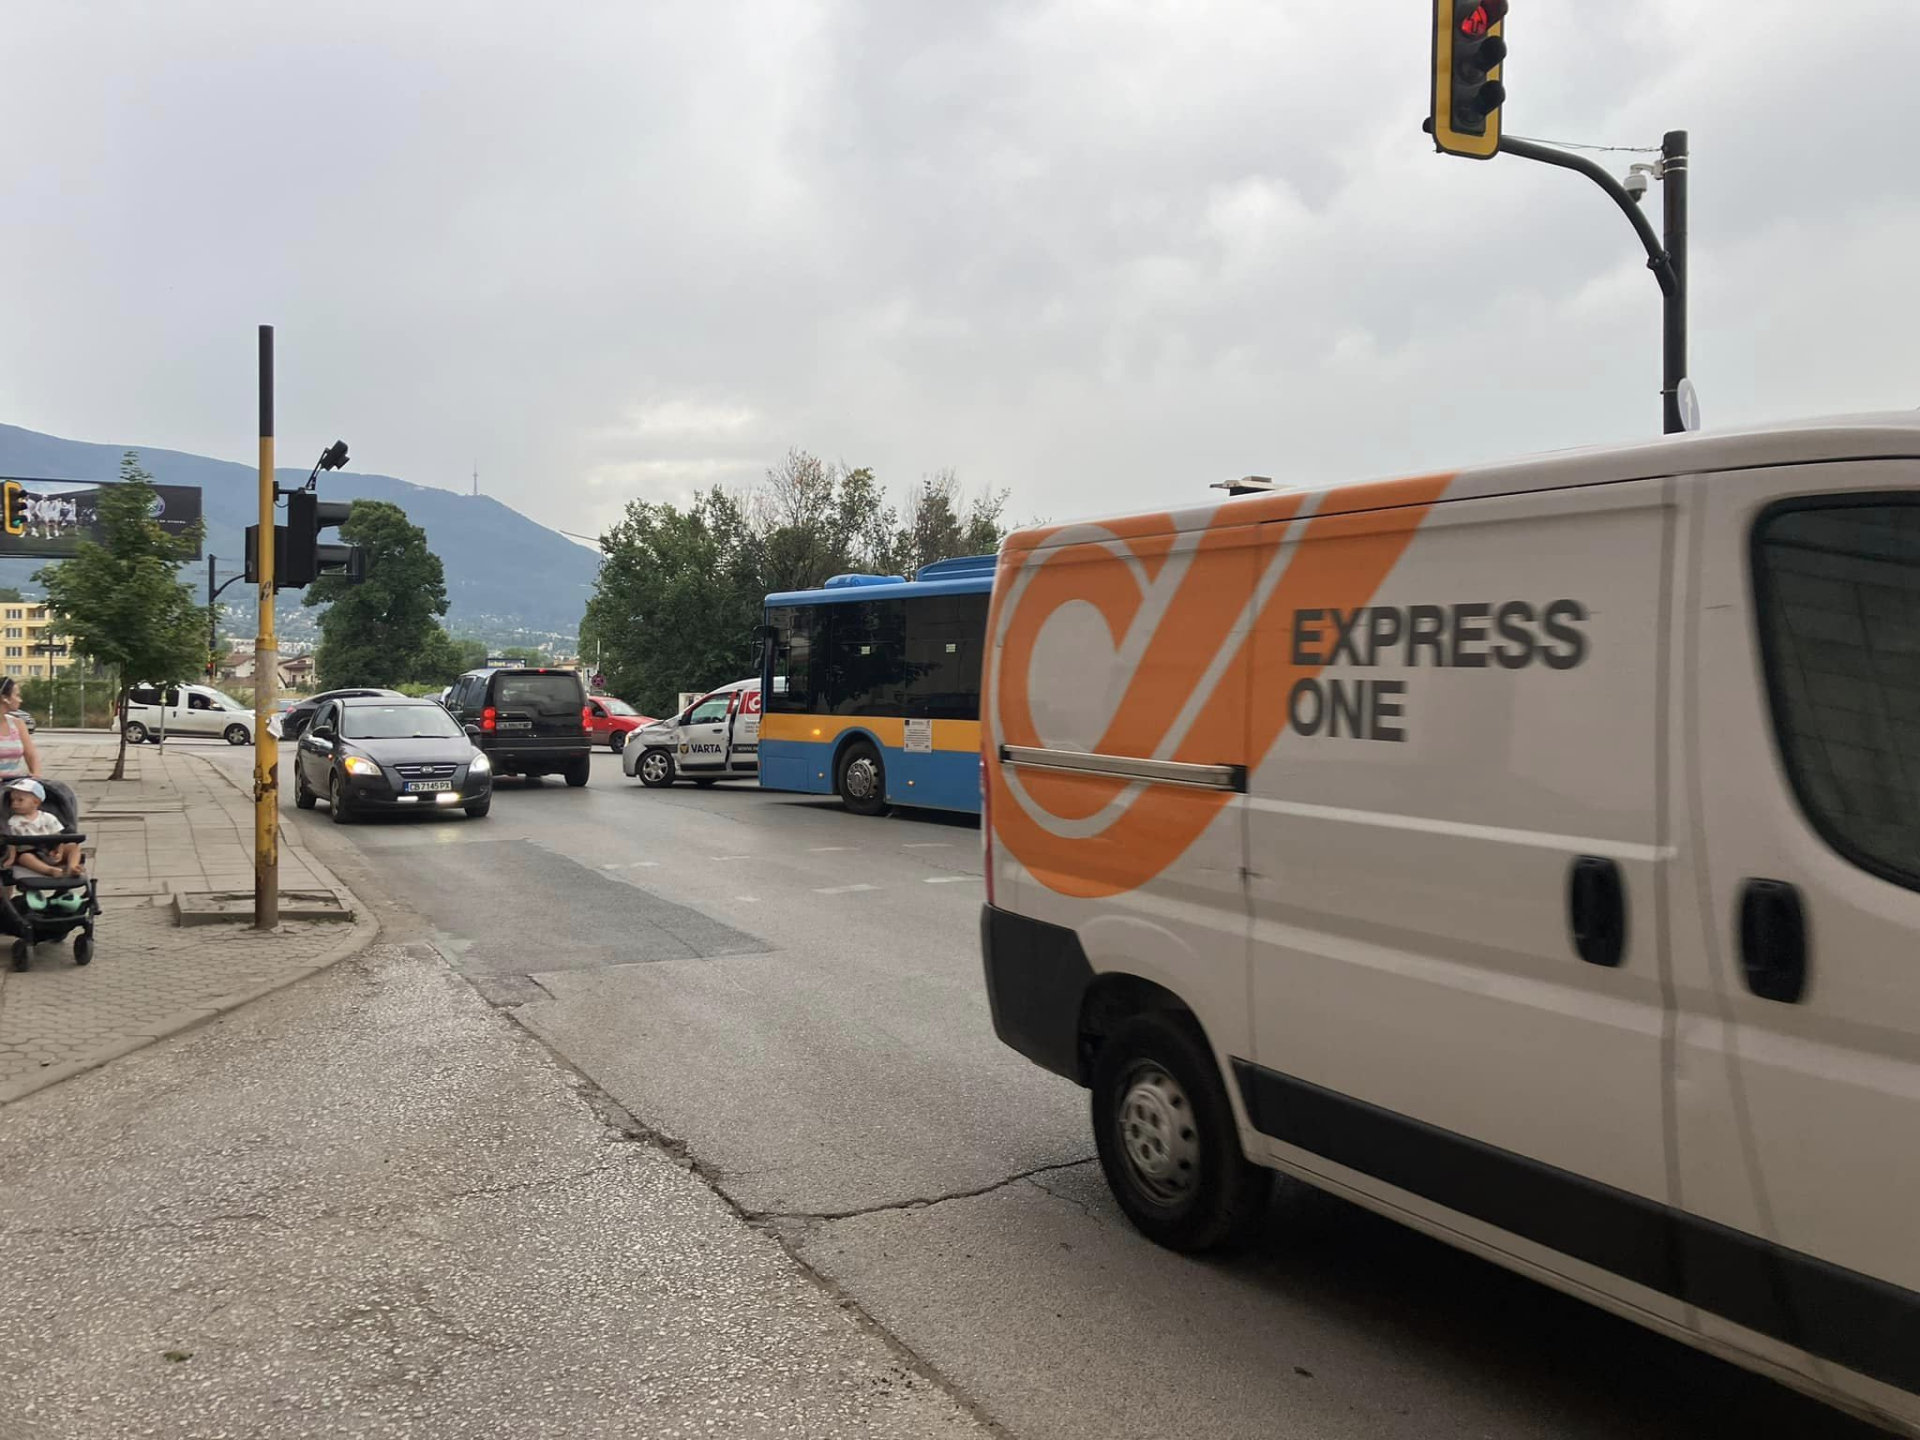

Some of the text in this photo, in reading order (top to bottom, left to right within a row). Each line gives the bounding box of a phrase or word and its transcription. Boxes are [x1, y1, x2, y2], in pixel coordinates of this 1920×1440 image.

[1290, 599, 1590, 670] EXPRESS
[1287, 677, 1409, 743] ONE
[691, 743, 722, 754] VARTA
